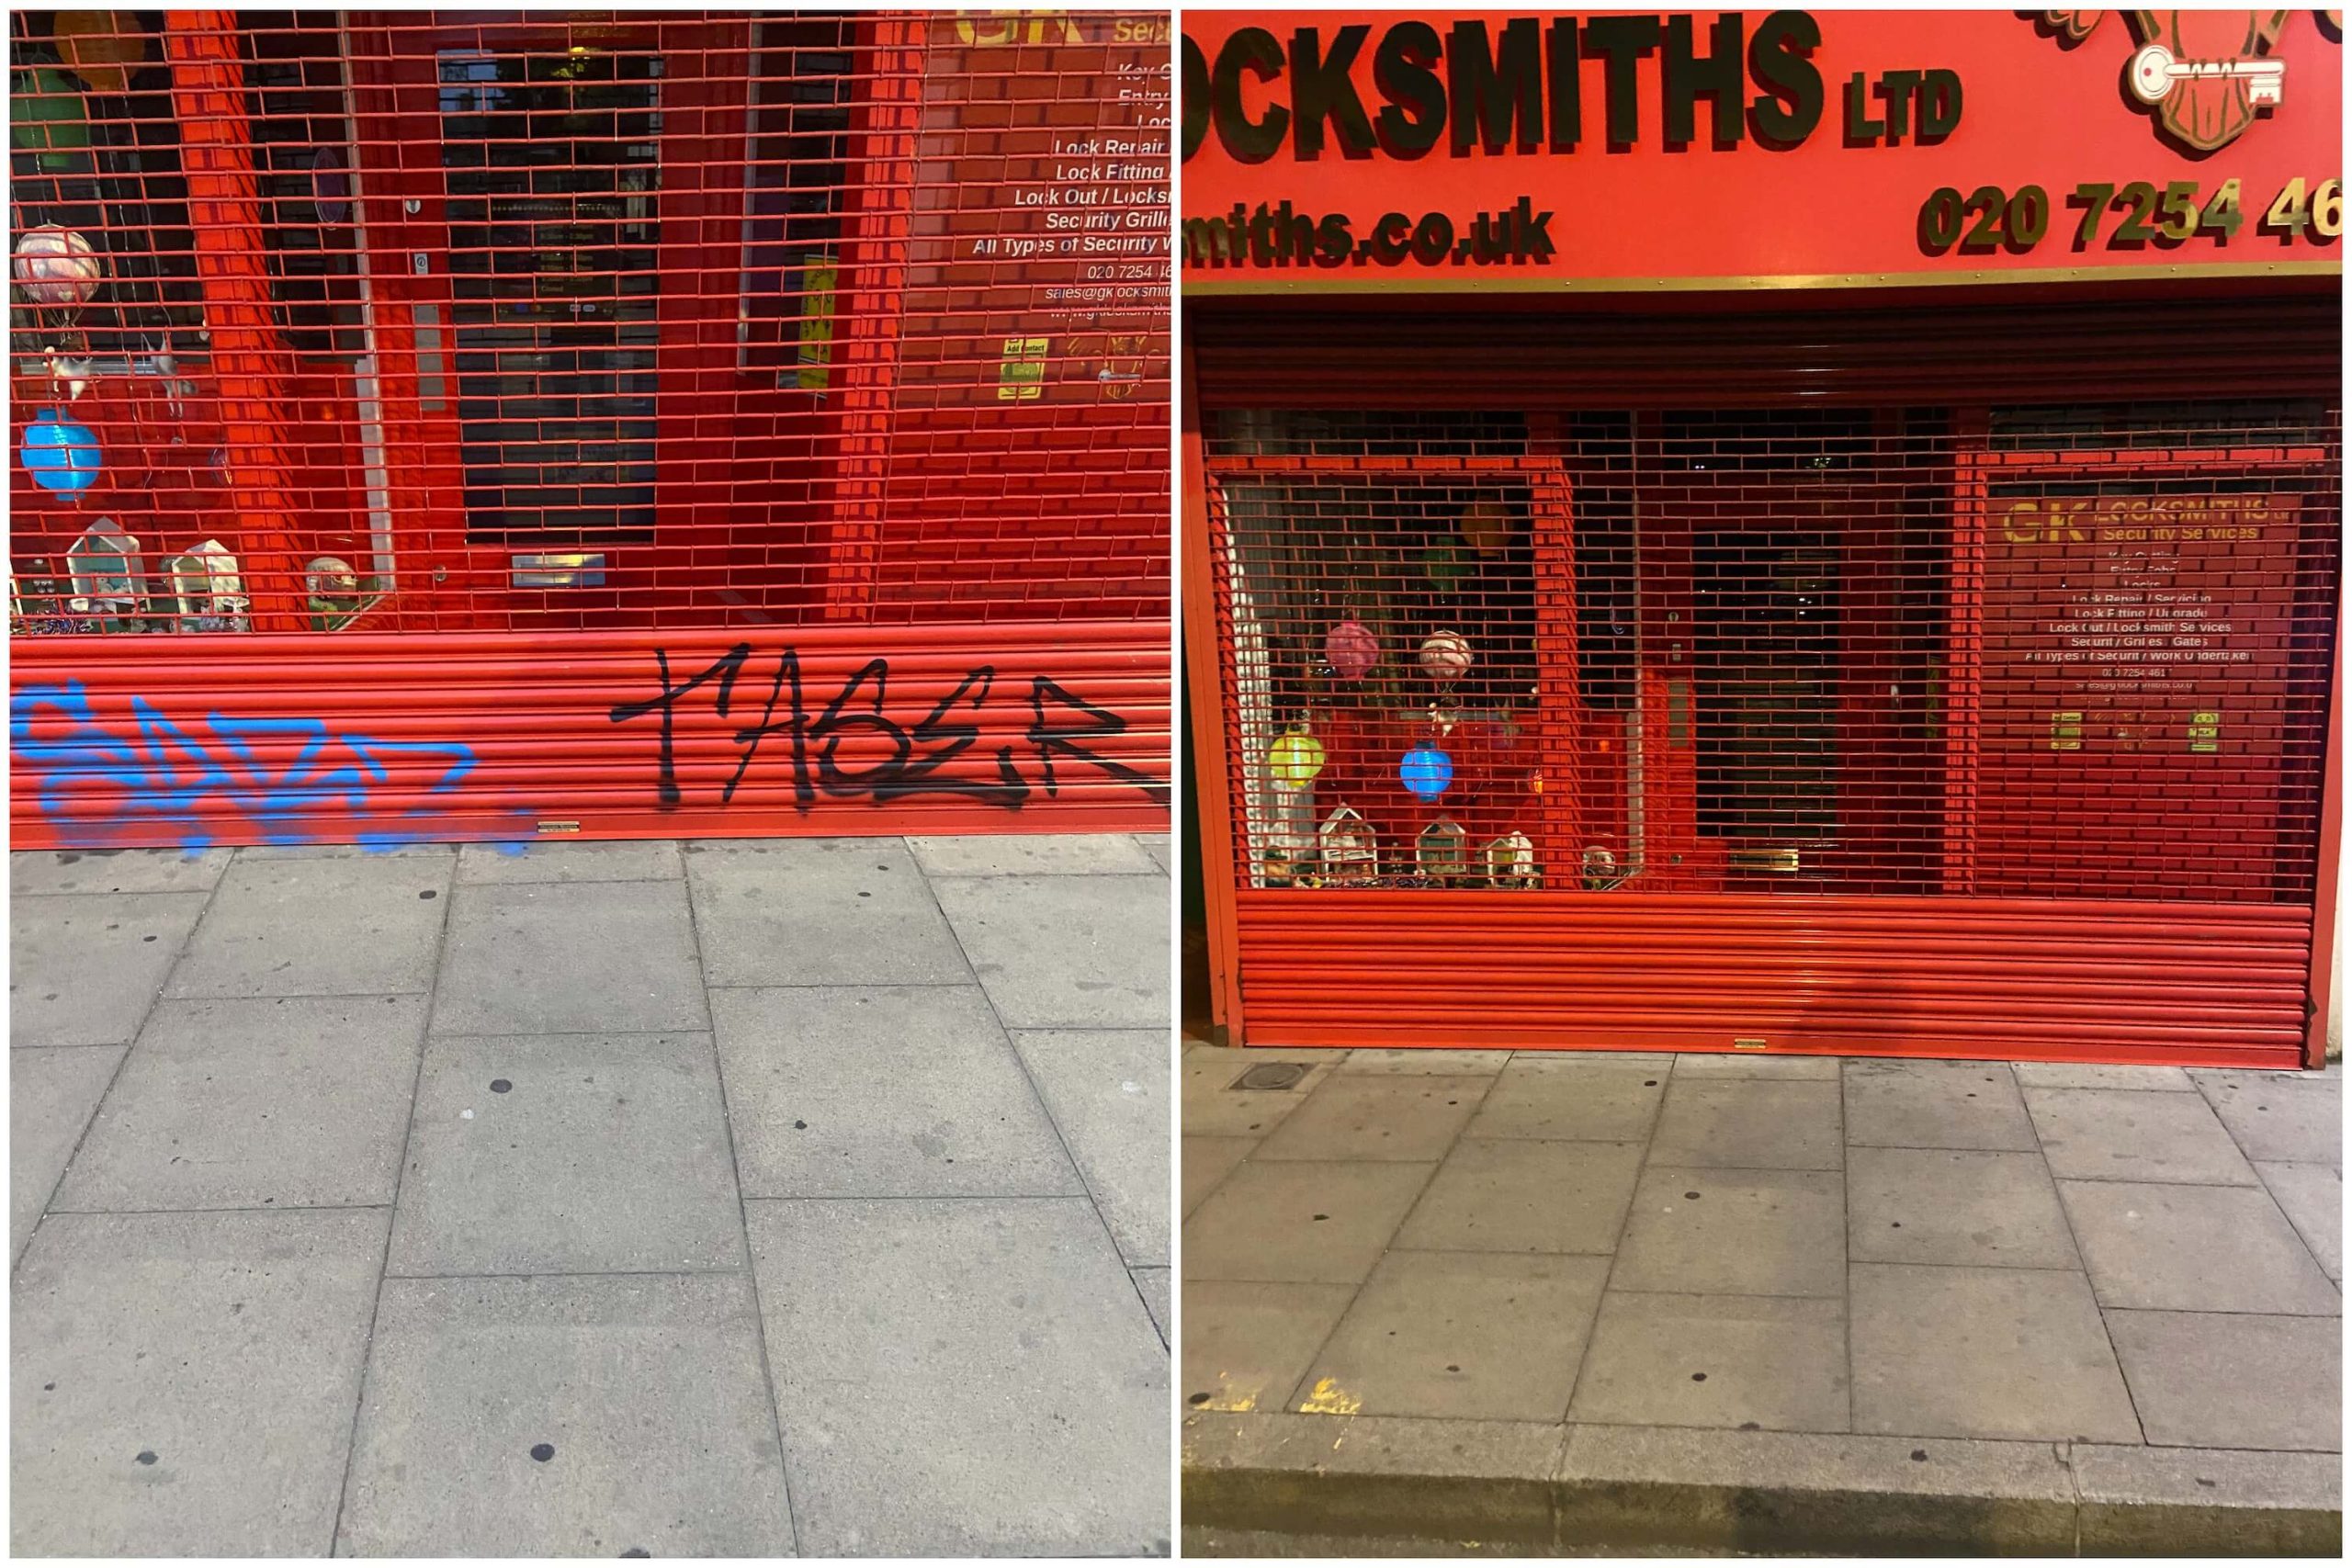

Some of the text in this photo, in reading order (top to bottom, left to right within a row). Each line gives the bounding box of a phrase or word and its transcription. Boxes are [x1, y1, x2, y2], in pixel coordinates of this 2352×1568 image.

[1843, 69, 1962, 148] LTD
[1055, 140, 1100, 154] Lock
[1057, 164, 1101, 180] Lock
[1015, 188, 1059, 205] Lock
[1065, 188, 1097, 204] Out
[1046, 211, 1121, 231] Security
[1917, 185, 2049, 257] 020
[2066, 178, 2243, 252] 7254
[2256, 177, 2343, 247] 46
[972, 239, 997, 254] All
[1003, 238, 1055, 256] Types
[1060, 237, 1079, 252] of
[1083, 234, 1158, 254] Security
[1088, 265, 1114, 279] 020
[1119, 265, 1152, 278] 7254
[2004, 502, 2087, 542] GK
[2107, 608, 2145, 618] Ftting
[2155, 607, 2208, 617] Ugrade
[2050, 623, 2078, 632] Lock
[2179, 622, 2232, 632] Sevices
[2123, 637, 2163, 647] Griles
[2173, 637, 2209, 647] Gates
[2148, 668, 2173, 677] 461
